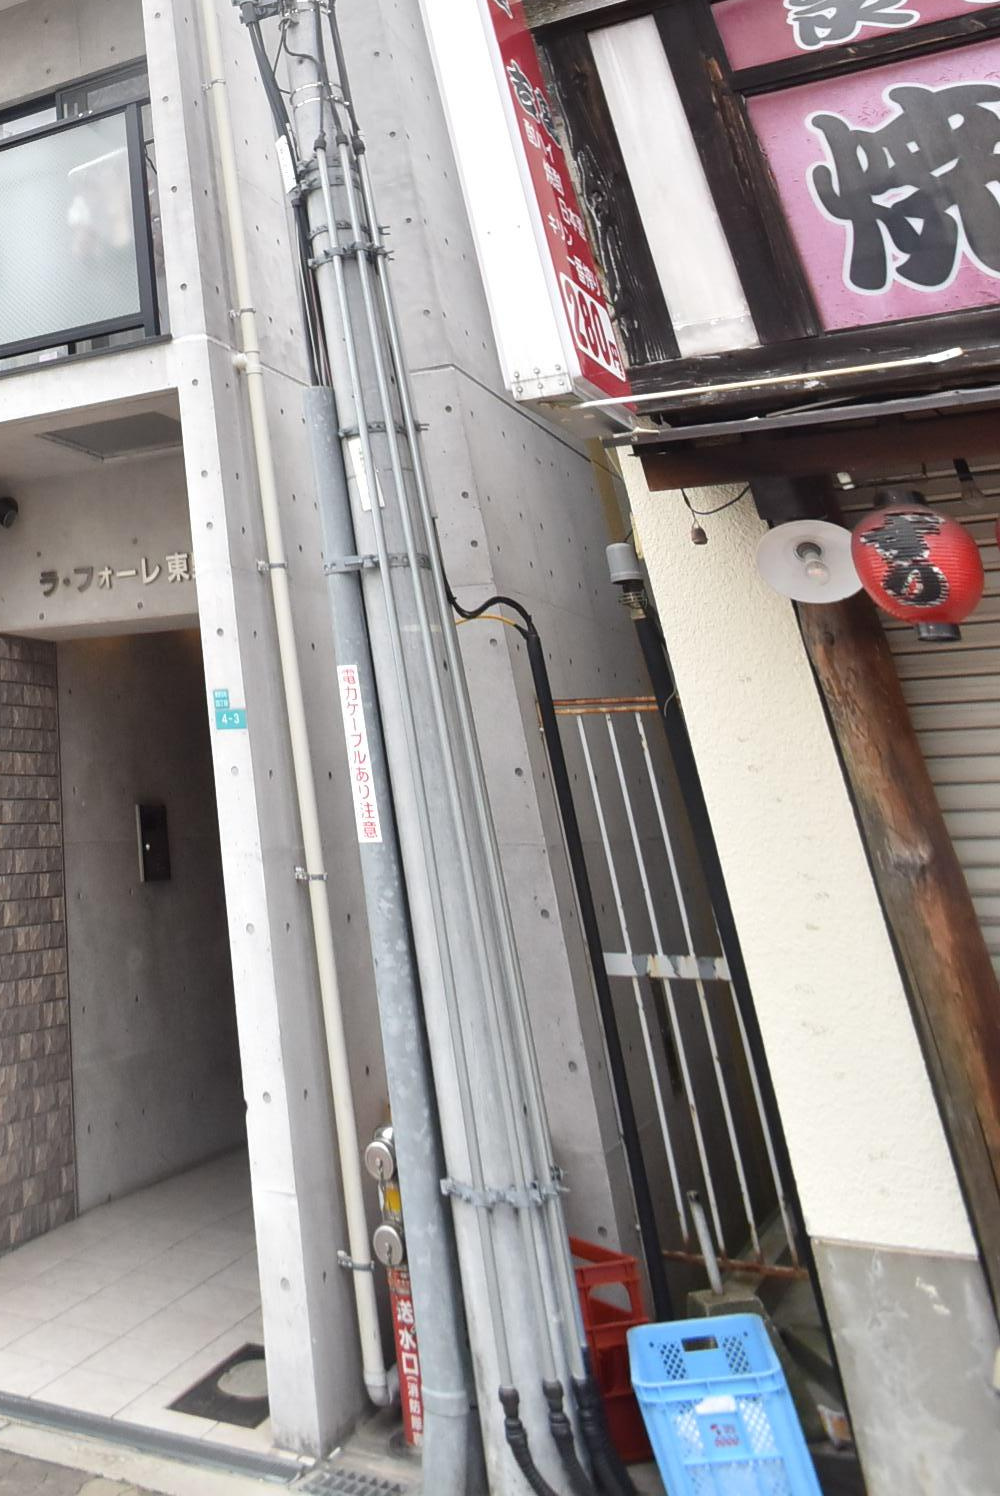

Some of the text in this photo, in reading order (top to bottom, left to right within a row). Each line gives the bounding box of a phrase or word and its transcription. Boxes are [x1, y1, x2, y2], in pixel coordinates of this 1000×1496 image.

[39, 552, 197, 598] ラ・フォーレ東
[221, 712, 241, 725] 4-3
[341, 668, 379, 839] 電力ケーブルあり注意
